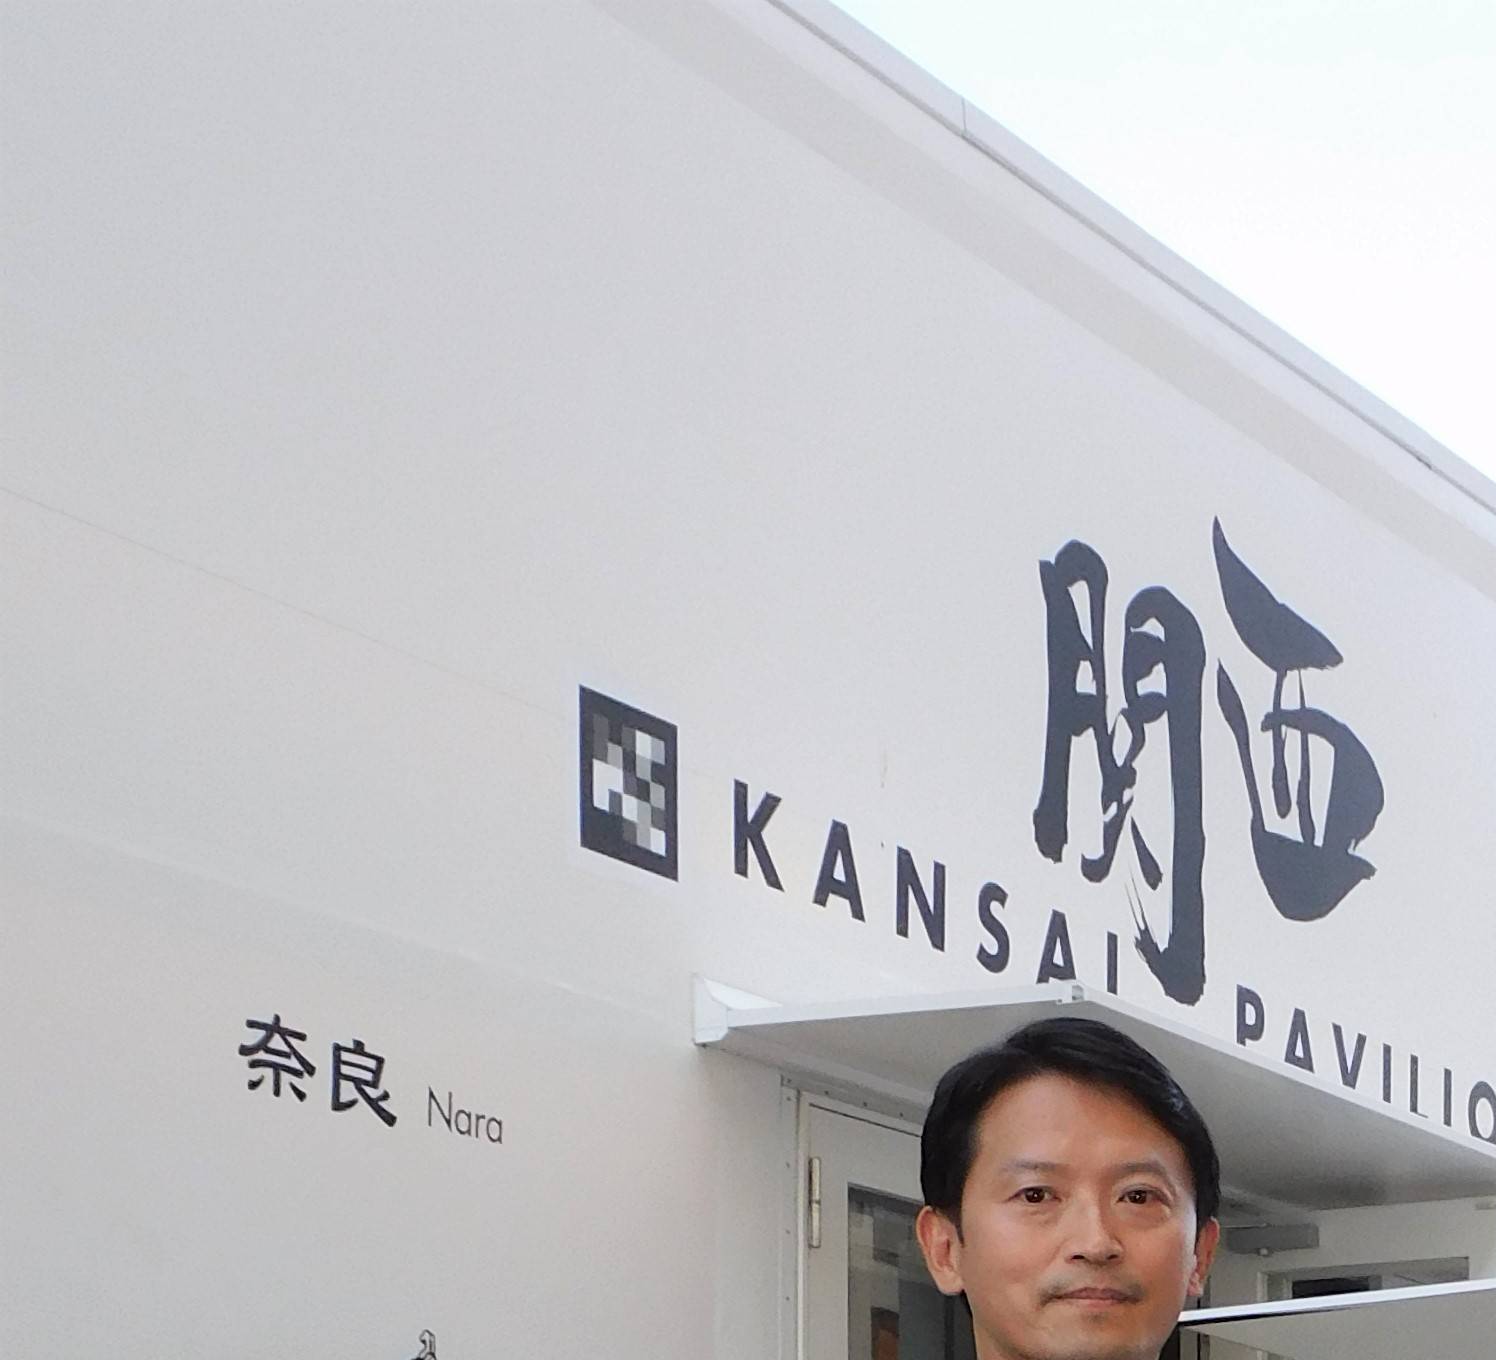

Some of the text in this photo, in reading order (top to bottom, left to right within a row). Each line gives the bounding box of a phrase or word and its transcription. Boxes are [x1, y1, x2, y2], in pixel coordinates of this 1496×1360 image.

[733, 778, 1118, 996] KANSAI
[238, 1013, 504, 1145] 奈良 Nara
